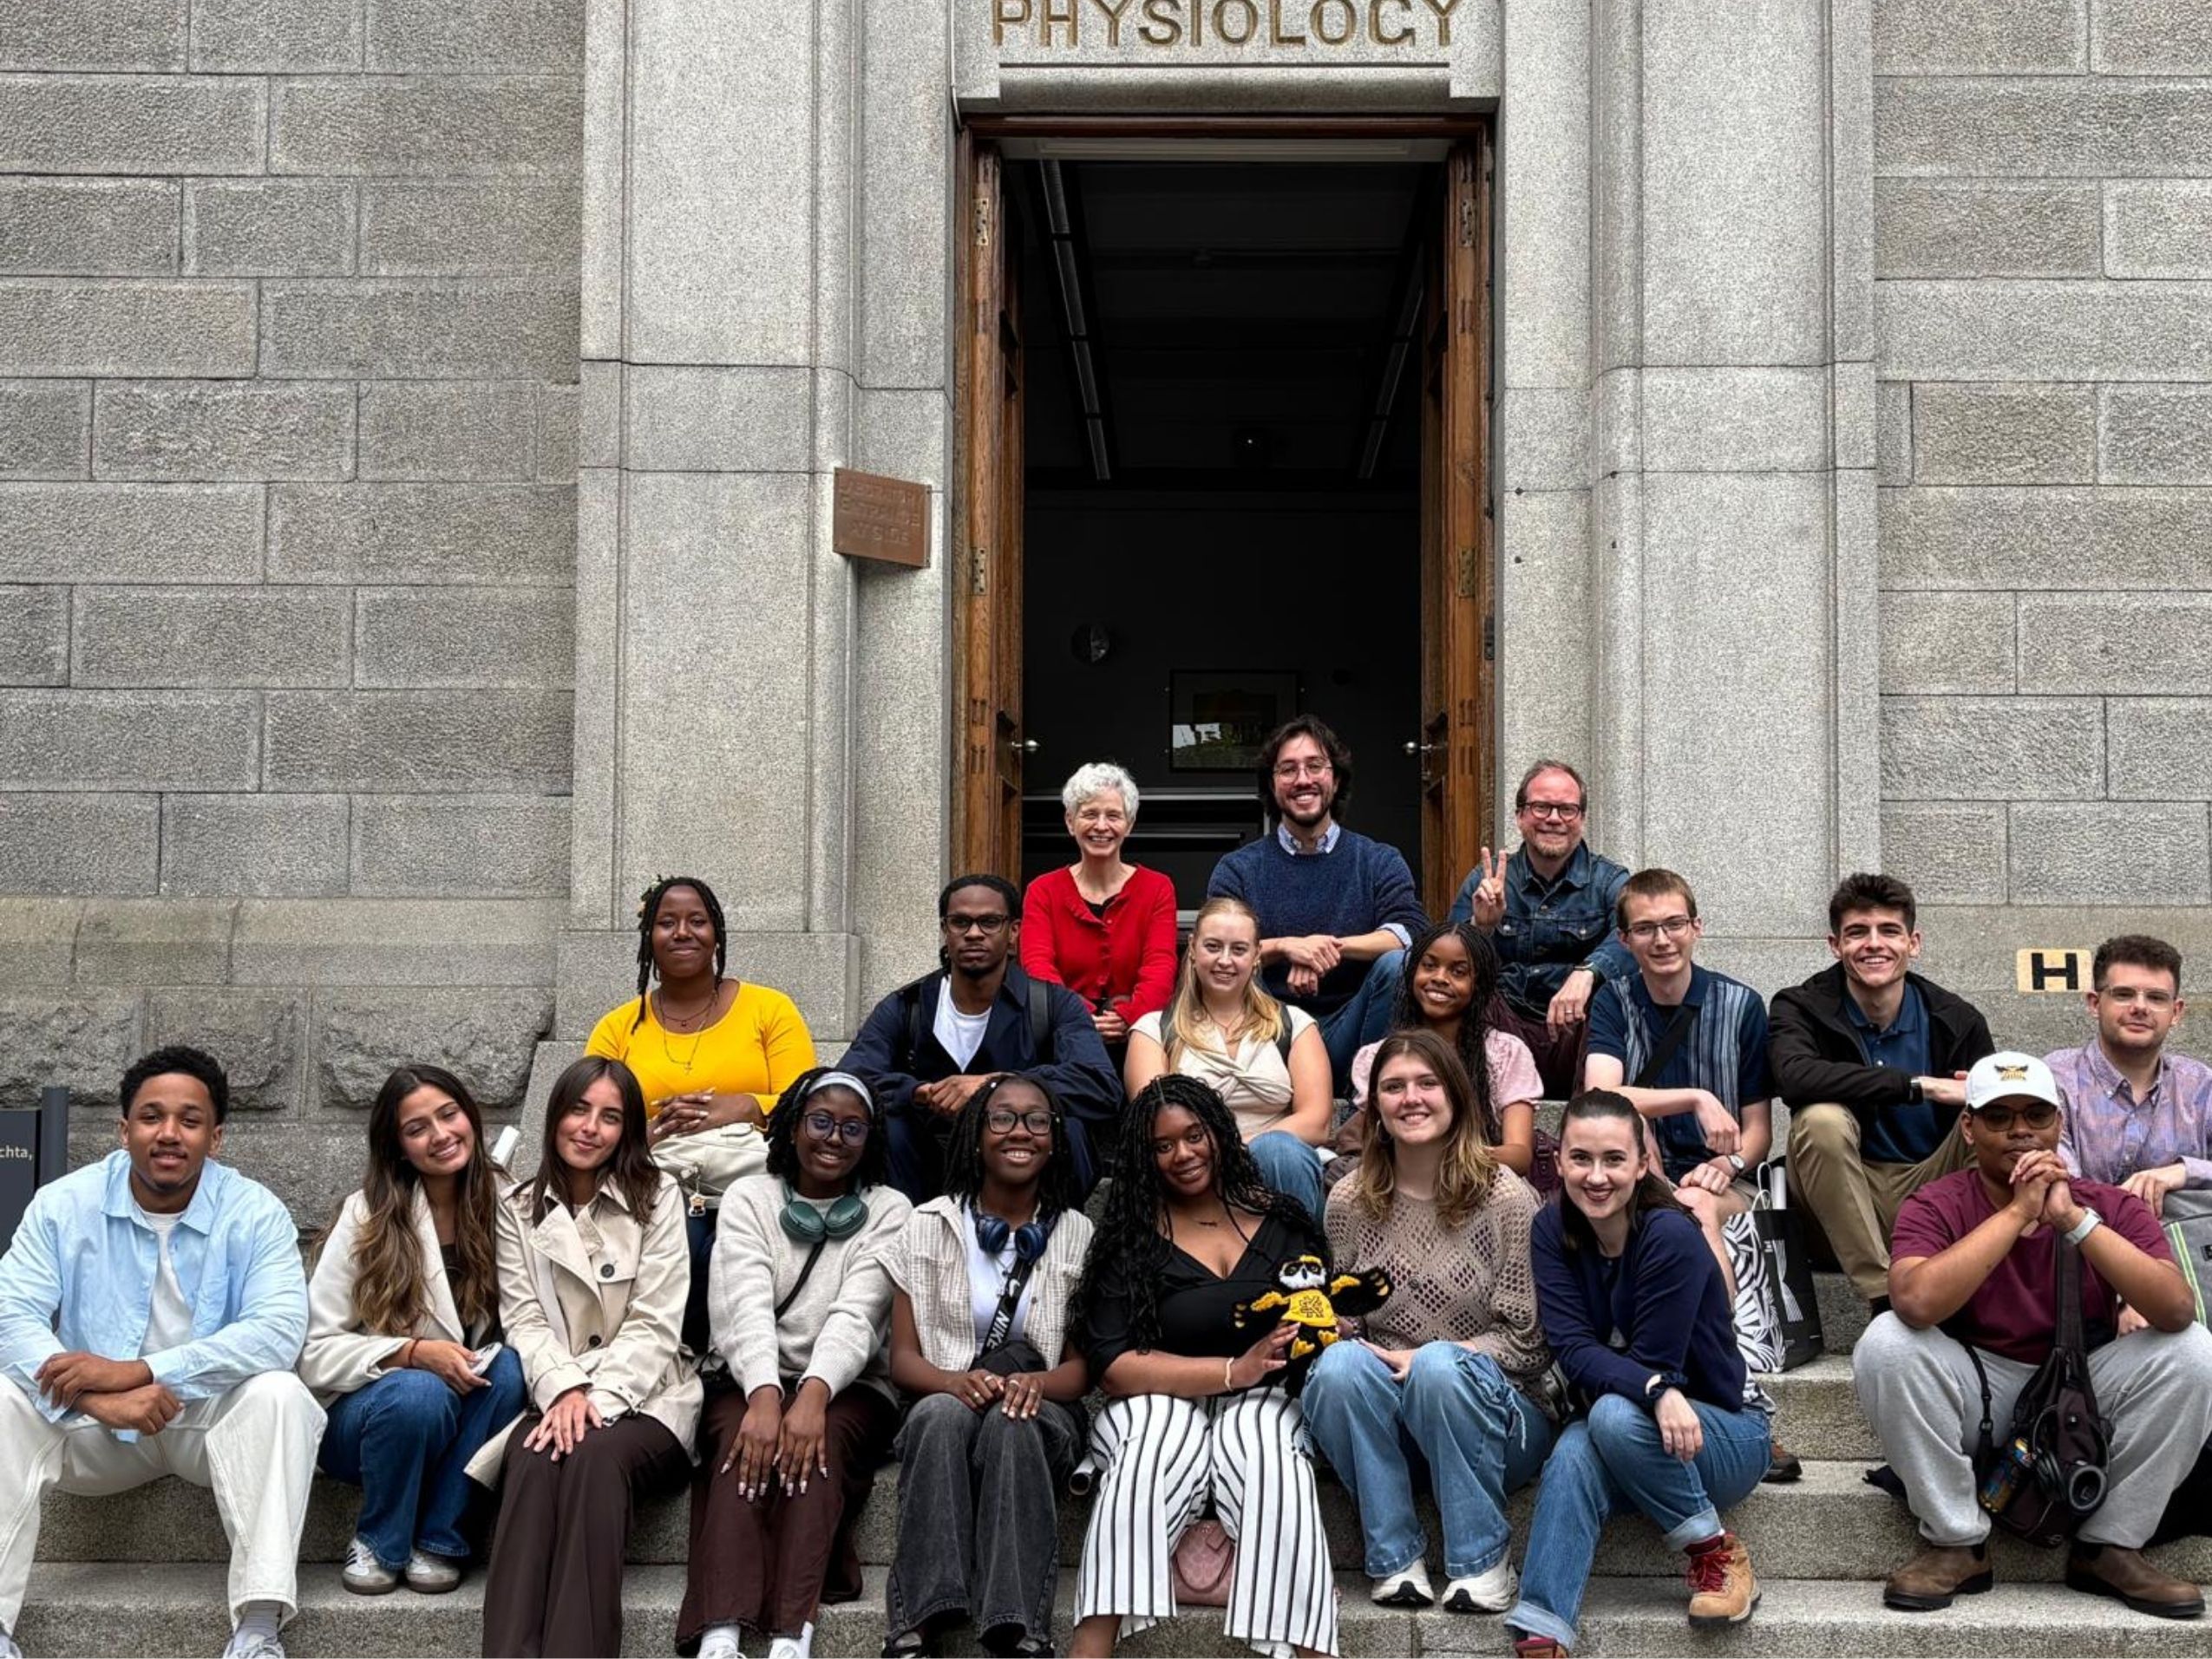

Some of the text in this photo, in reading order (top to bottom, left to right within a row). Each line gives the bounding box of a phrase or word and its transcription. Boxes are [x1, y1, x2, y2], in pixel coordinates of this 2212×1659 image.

[992, 0, 1457, 46] PHYSIOLOGY
[2032, 952, 2078, 990] H
[986, 1310, 1010, 1349] NIKE
